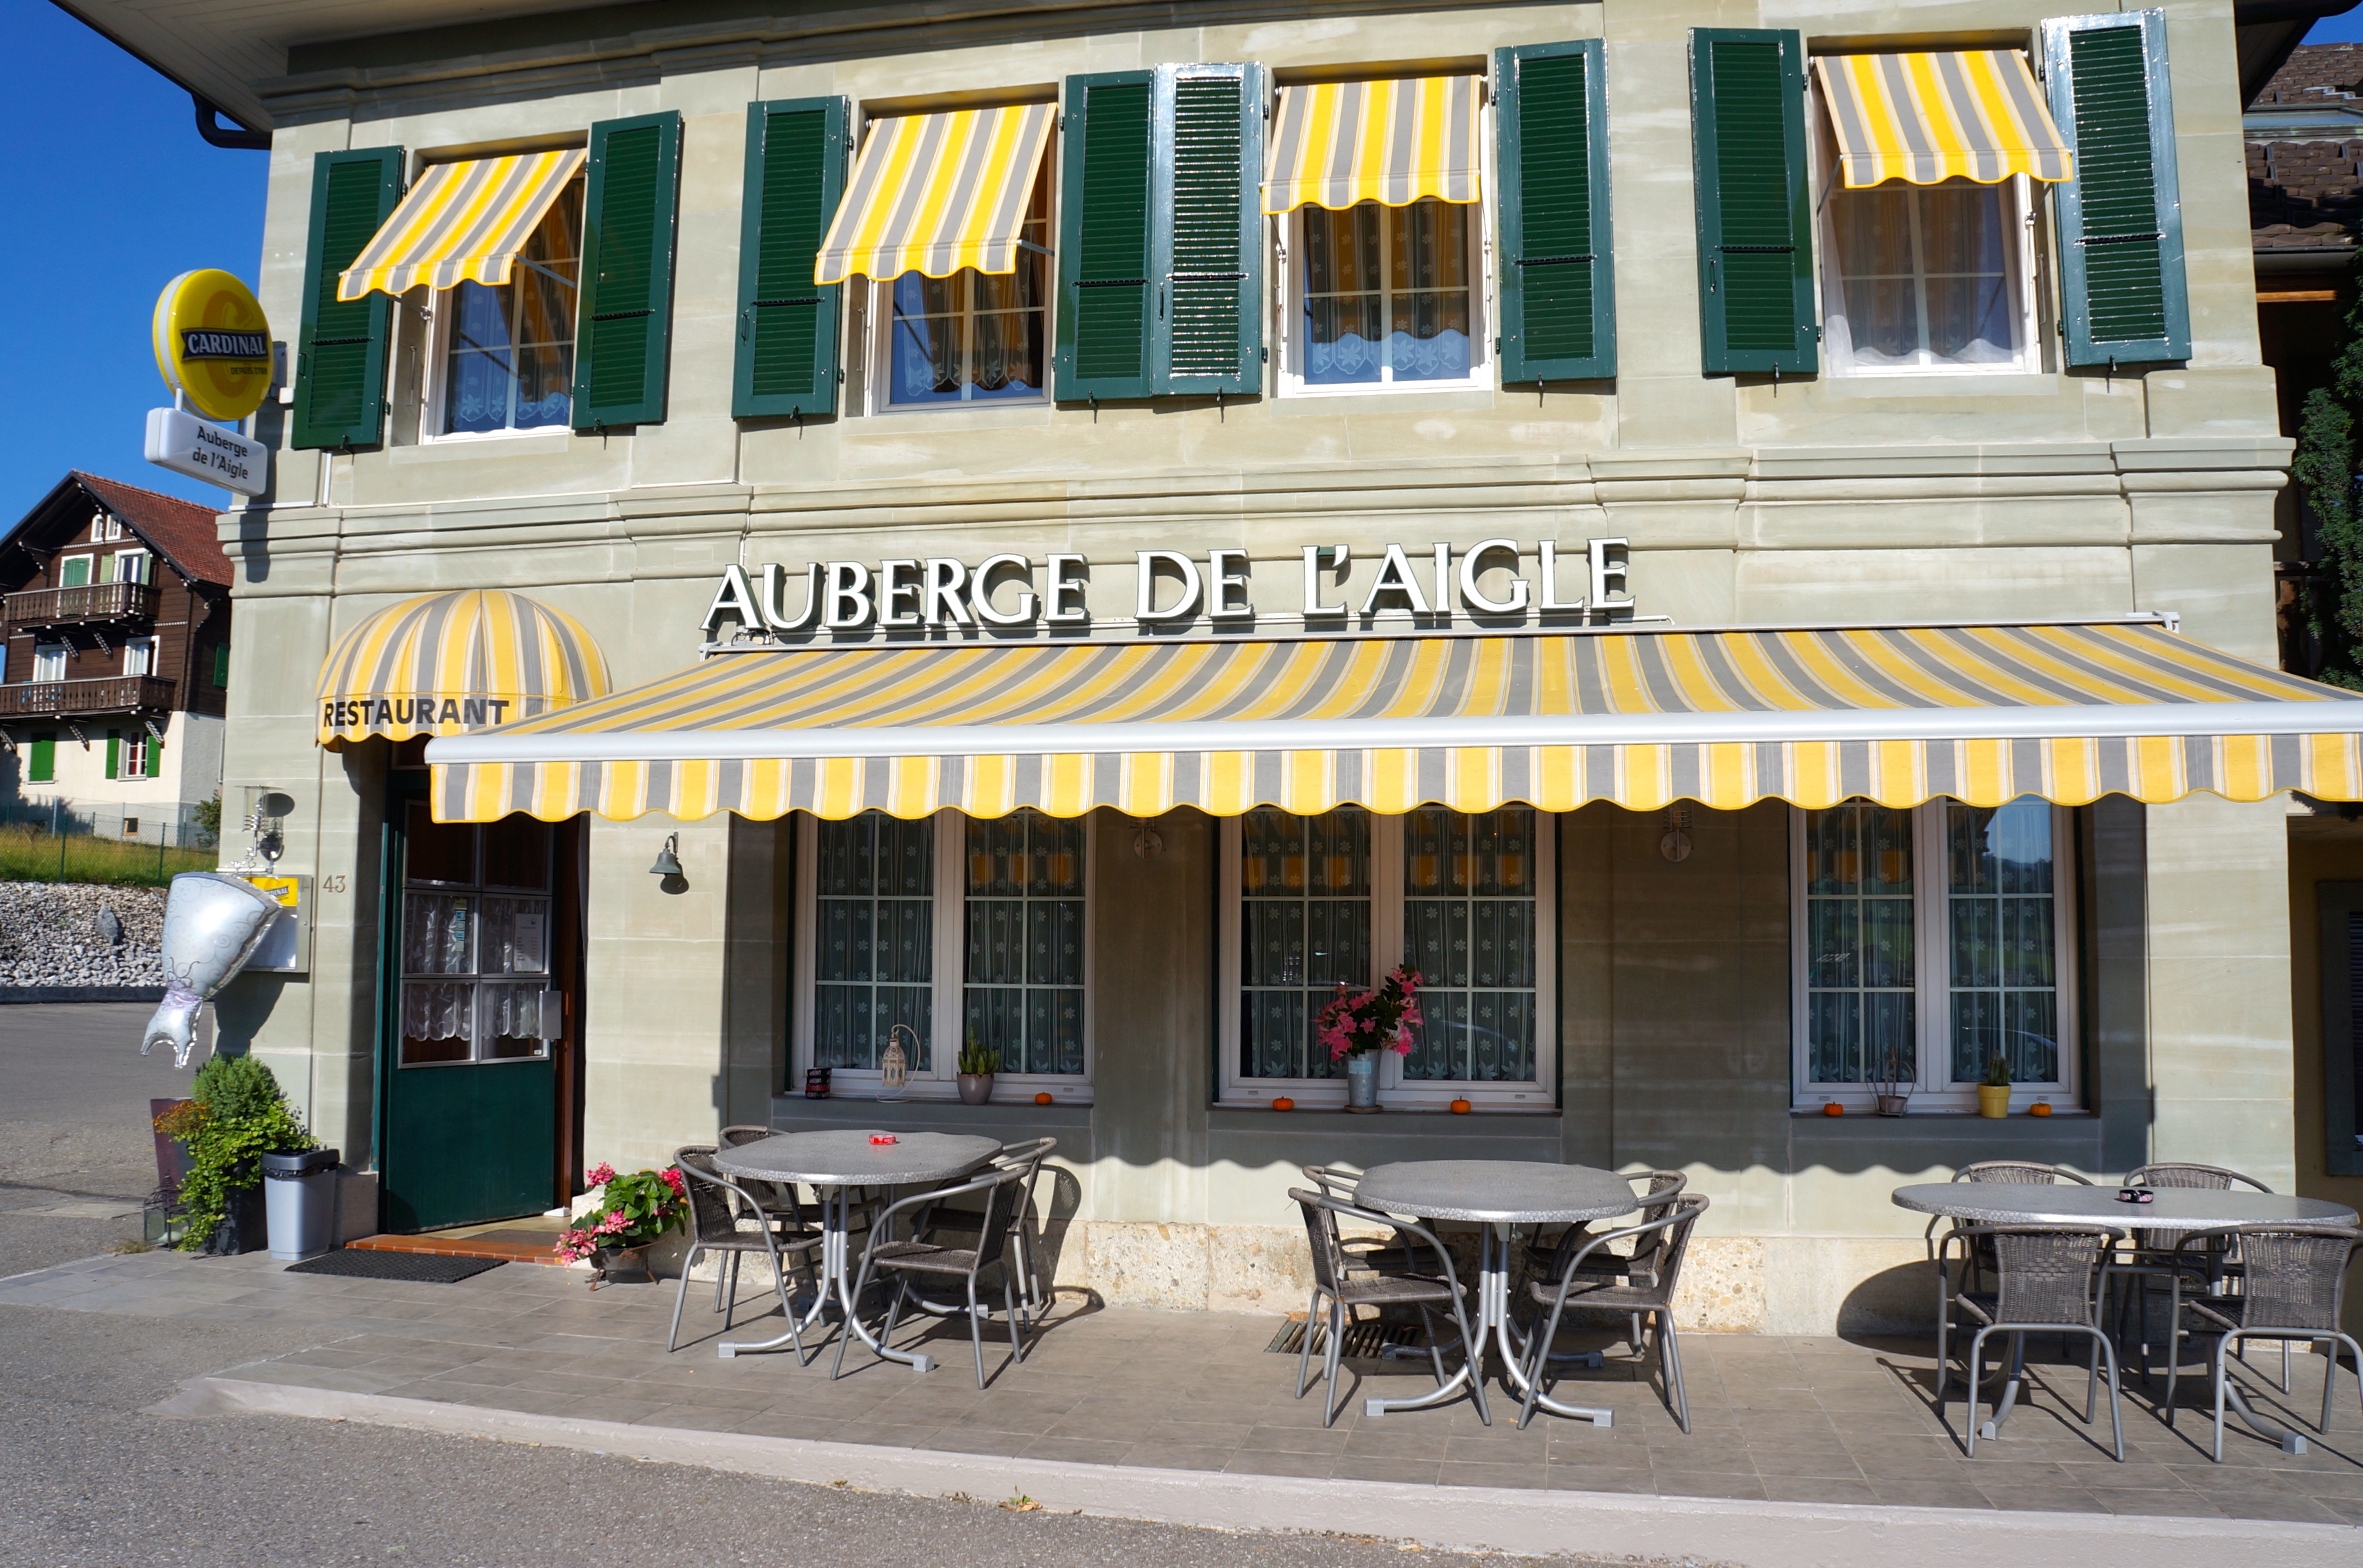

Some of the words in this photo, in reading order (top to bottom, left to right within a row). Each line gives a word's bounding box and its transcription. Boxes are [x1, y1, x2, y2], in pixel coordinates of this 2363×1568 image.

[188, 333, 267, 354] CARDINAL
[231, 367, 253, 375] DEPUIS
[197, 425, 248, 457] Auberge
[193, 447, 208, 465] de
[211, 452, 249, 479] l'Aigle
[699, 553, 1090, 631] AUBERGE
[1134, 549, 1255, 620] DE
[1301, 536, 1636, 617] L'AIGLE
[323, 699, 510, 727] RESTAURANT
[322, 875, 346, 893] 43
